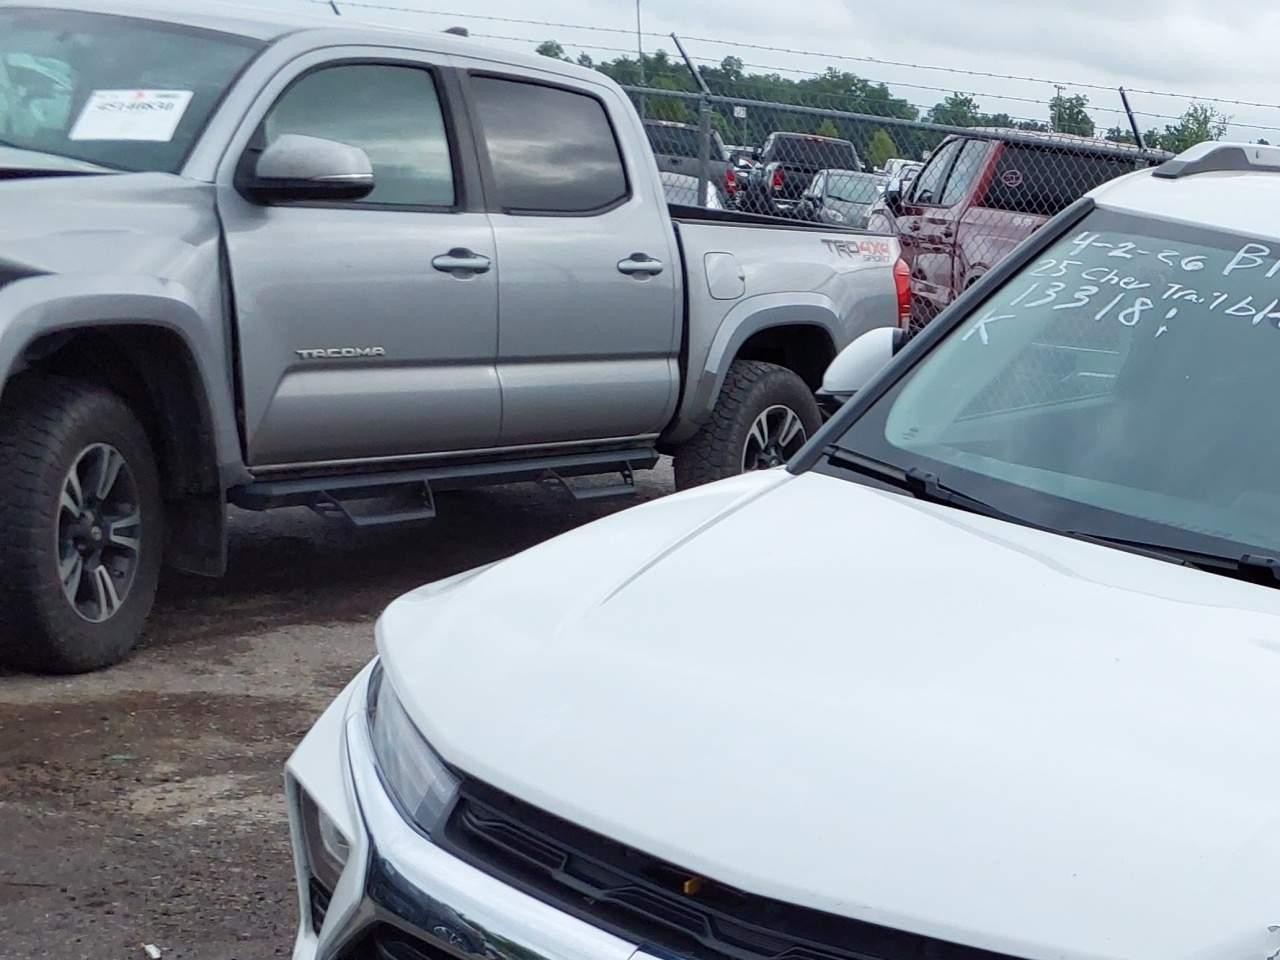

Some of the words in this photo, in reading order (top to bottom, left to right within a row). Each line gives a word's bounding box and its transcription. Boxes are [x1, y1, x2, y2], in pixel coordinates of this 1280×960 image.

[1029, 259, 1084, 277] 25
[961, 309, 1016, 345] K
[295, 346, 386, 359] TACOMA
